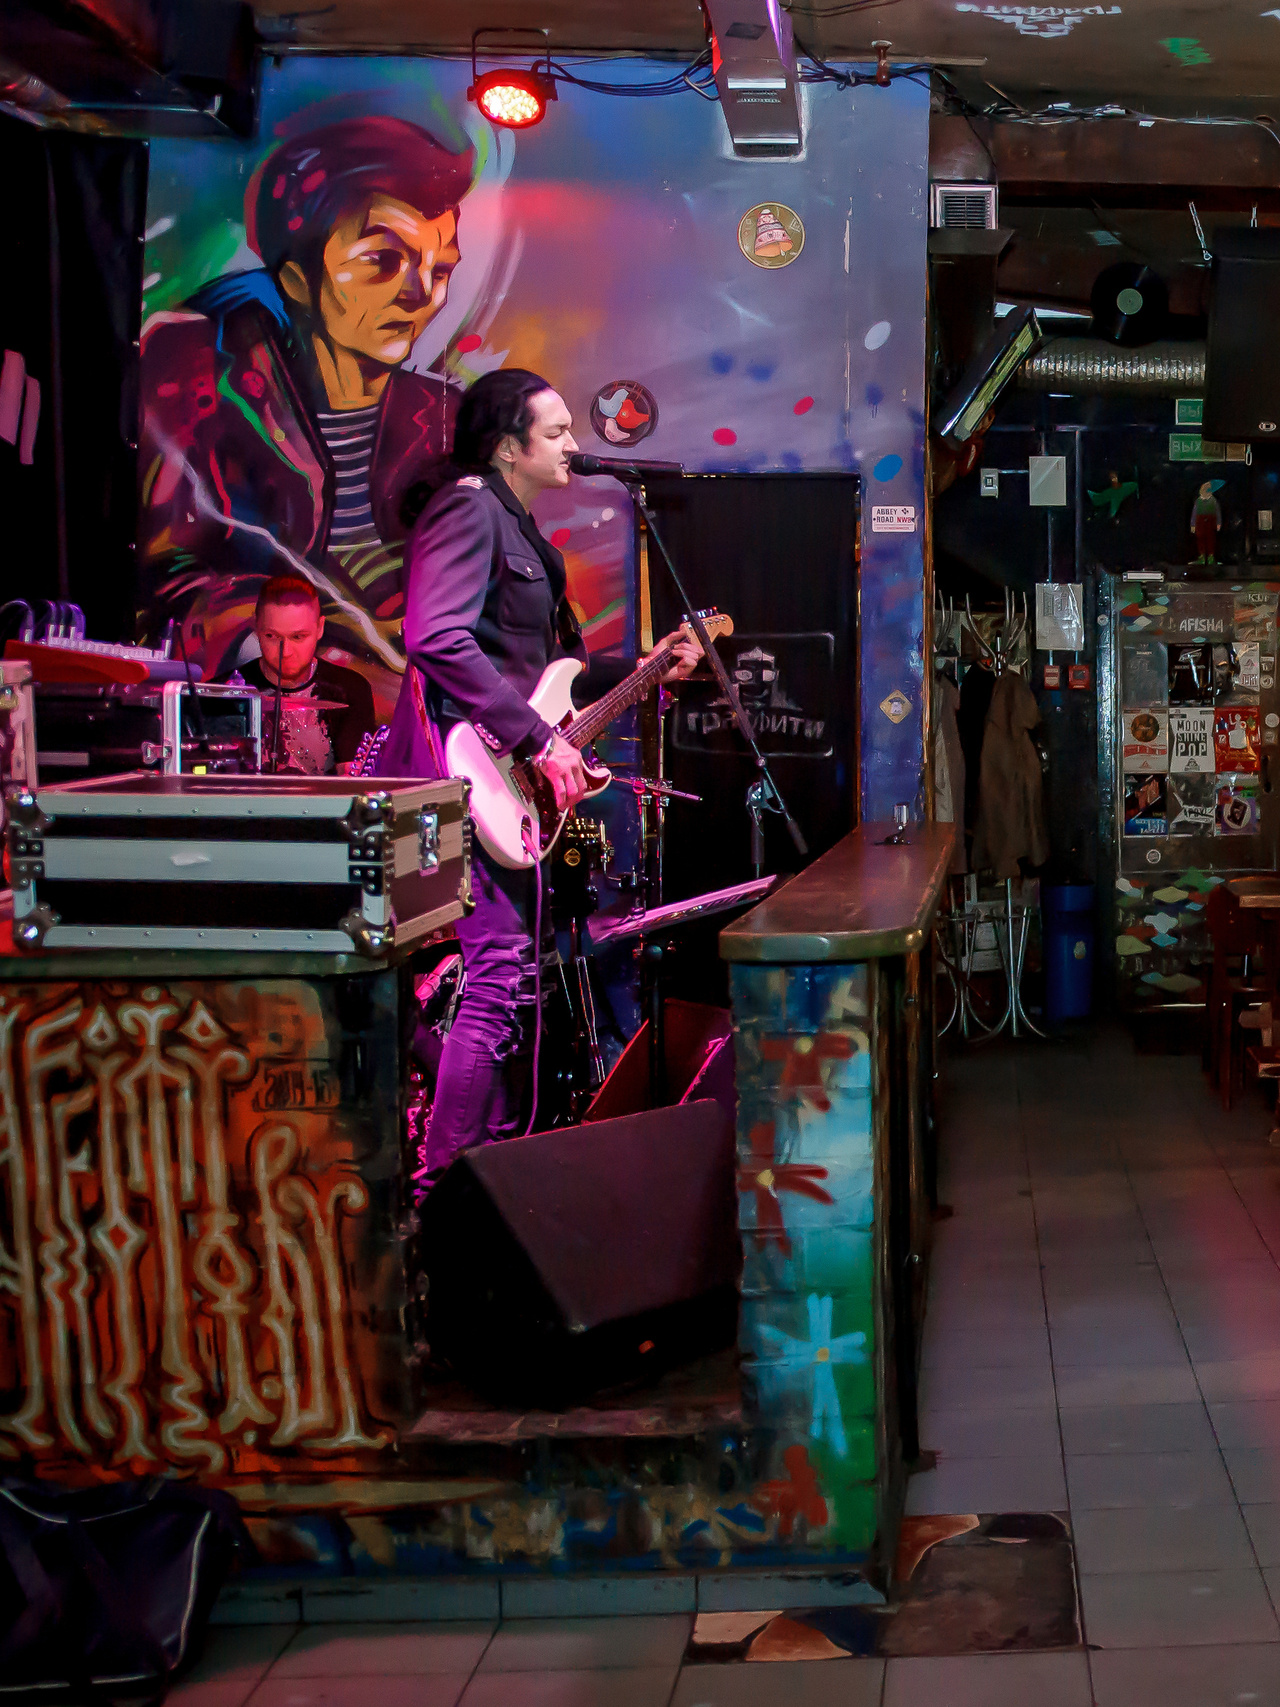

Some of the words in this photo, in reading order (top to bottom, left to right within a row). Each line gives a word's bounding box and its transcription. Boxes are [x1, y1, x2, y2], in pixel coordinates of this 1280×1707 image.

[1179, 617, 1224, 633] AFISHA
[1177, 719, 1206, 731] MOON
[1177, 732, 1206, 742] SHINE
[1177, 742, 1207, 756] POP
